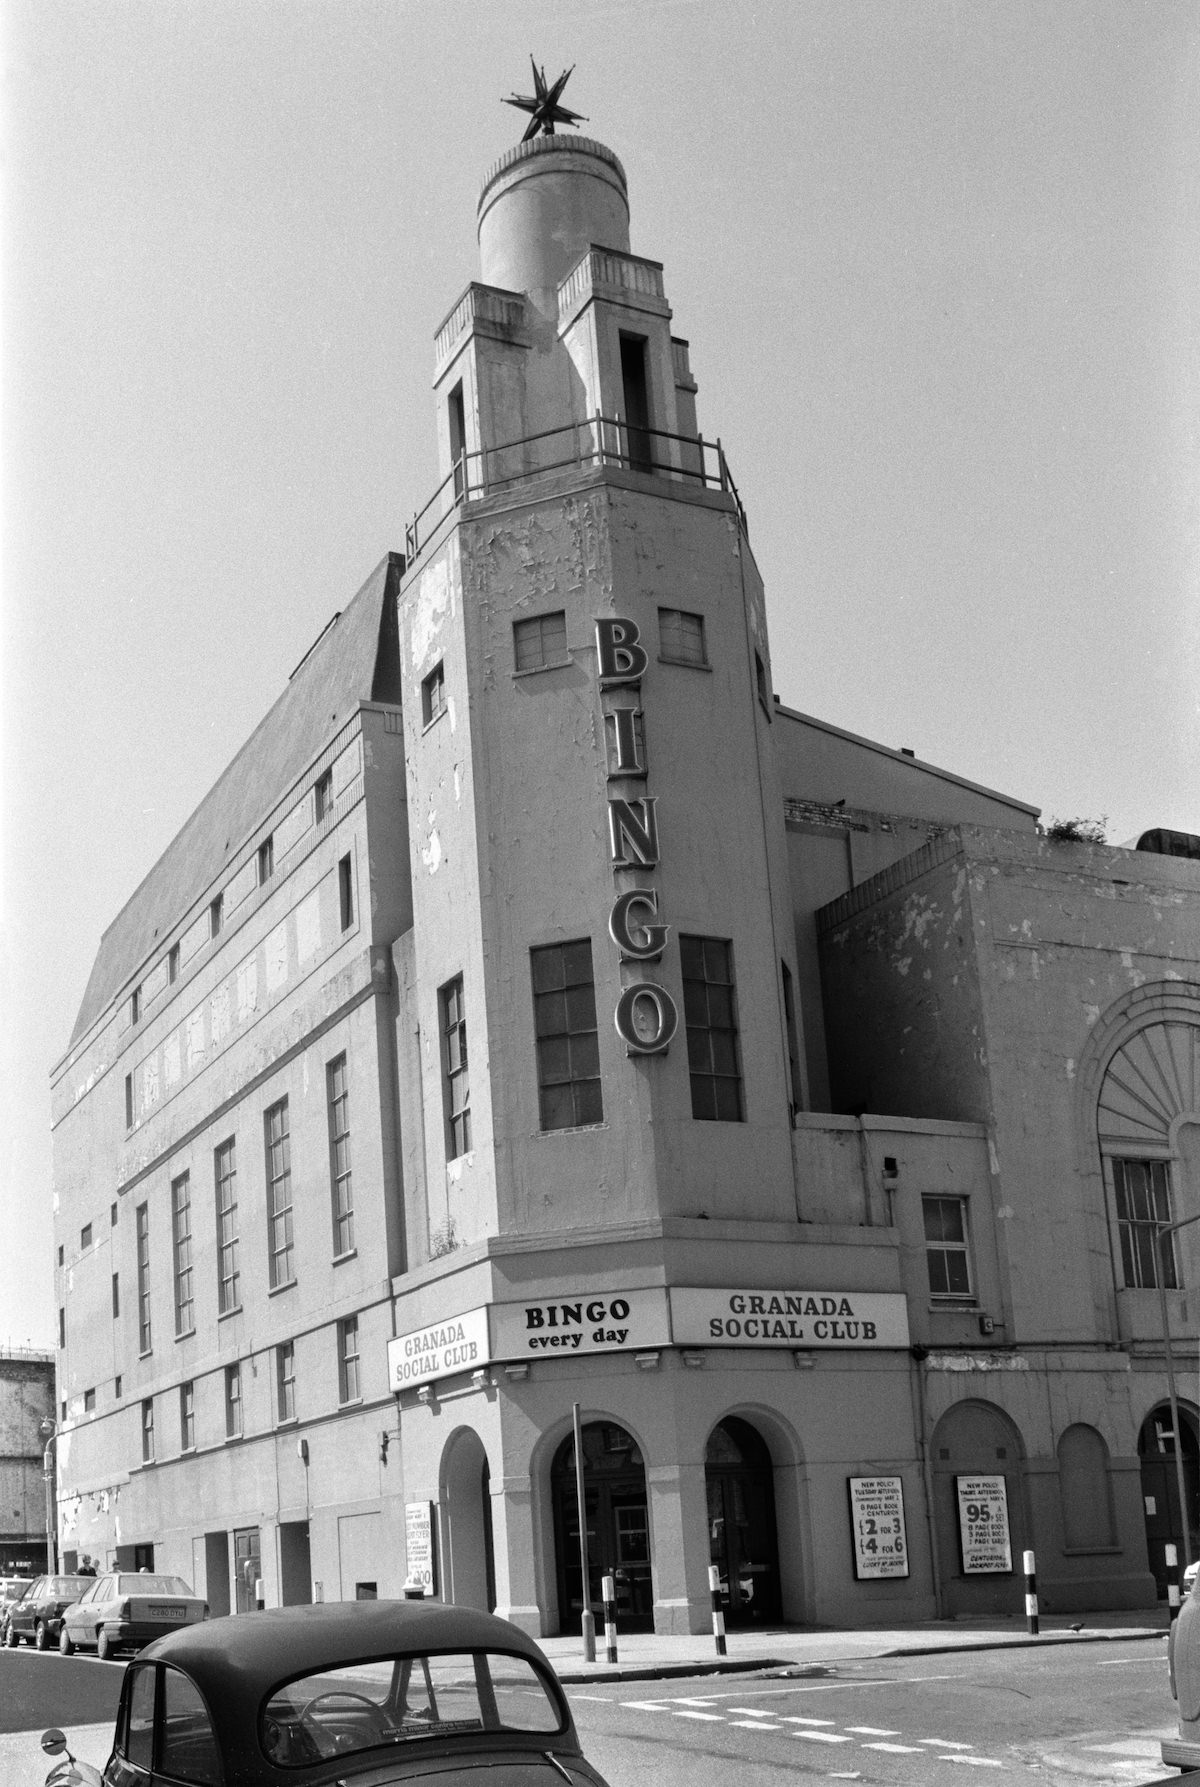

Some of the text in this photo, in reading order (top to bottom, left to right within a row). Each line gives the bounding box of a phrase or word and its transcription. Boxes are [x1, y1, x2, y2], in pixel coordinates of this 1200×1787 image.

[593, 617, 678, 1053] BINGO
[525, 1299, 630, 1329] BINGO
[729, 1295, 854, 1316] GRANADA
[529, 1328, 629, 1348] every day
[709, 1318, 877, 1339] SOCIAL CLUB
[404, 1322, 465, 1357] GRANADA
[396, 1341, 478, 1382] SOCIAL CLUB
[859, 1517, 901, 1535] £2 FOR 3
[995, 1514, 1004, 1522] SET
[860, 1536, 903, 1554] £4 FOR 6
